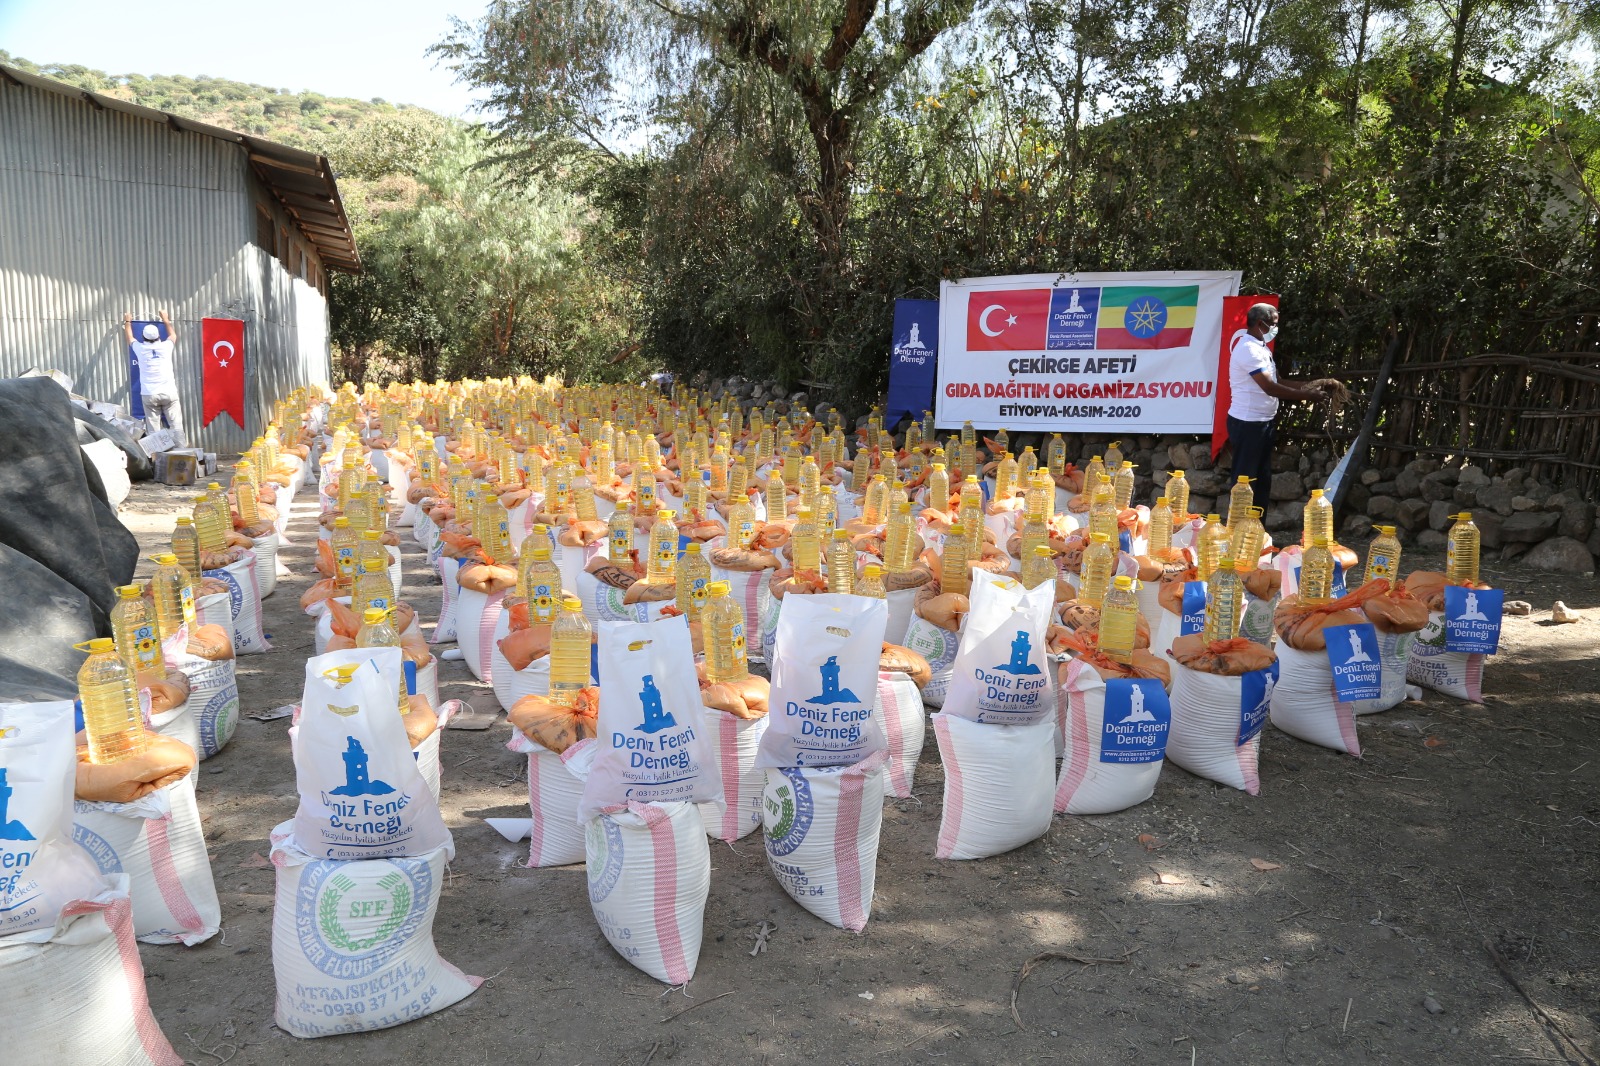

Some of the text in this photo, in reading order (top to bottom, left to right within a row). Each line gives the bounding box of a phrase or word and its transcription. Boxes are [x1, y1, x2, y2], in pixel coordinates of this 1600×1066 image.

[1060, 320, 1084, 328] Derneği
[894, 348, 934, 356] Deniz Feneri
[900, 355, 926, 366] Derneği
[1008, 354, 1137, 376] ÇEKİRGE AFETİ
[945, 379, 1213, 399] GIDA DAĞITIM ORGANİZASYONU
[999, 402, 1142, 418] ETİYOPYA-KASIM-2020
[1184, 614, 1204, 623] Deni
[1446, 620, 1499, 631] Deniz Feneri
[1455, 628, 1489, 640] Derneği
[916, 638, 932, 649] SFF
[1412, 644, 1425, 655] OUR
[1334, 662, 1380, 675] Deniz Feneri
[1409, 655, 1448, 670] /SPECIAL
[975, 668, 1012, 689] Deniz
[1348, 672, 1377, 683] Derneği
[987, 686, 1040, 705] Derneği
[786, 702, 828, 723] Deniz
[801, 720, 861, 742] Derneği
[1106, 721, 1168, 734] Deniz Feneri
[612, 726, 695, 752] Deniz Feneri
[1117, 733, 1156, 746] Derneği
[630, 748, 690, 770] Derneği
[321, 825, 413, 845] Yüzyılın İyilik Hareketi
[84, 832, 118, 869] SEMER
[7, 907, 36, 924] 30 30
[350, 900, 388, 918] SFF
[618, 927, 632, 940] 29
[298, 917, 326, 964] SEMER
[324, 956, 373, 976] FLOUR
[625, 947, 640, 958] 84
[370, 993, 388, 1011] 37
[391, 982, 411, 1001] 71
[401, 1000, 421, 1018] 75
[421, 985, 438, 1005] 84
